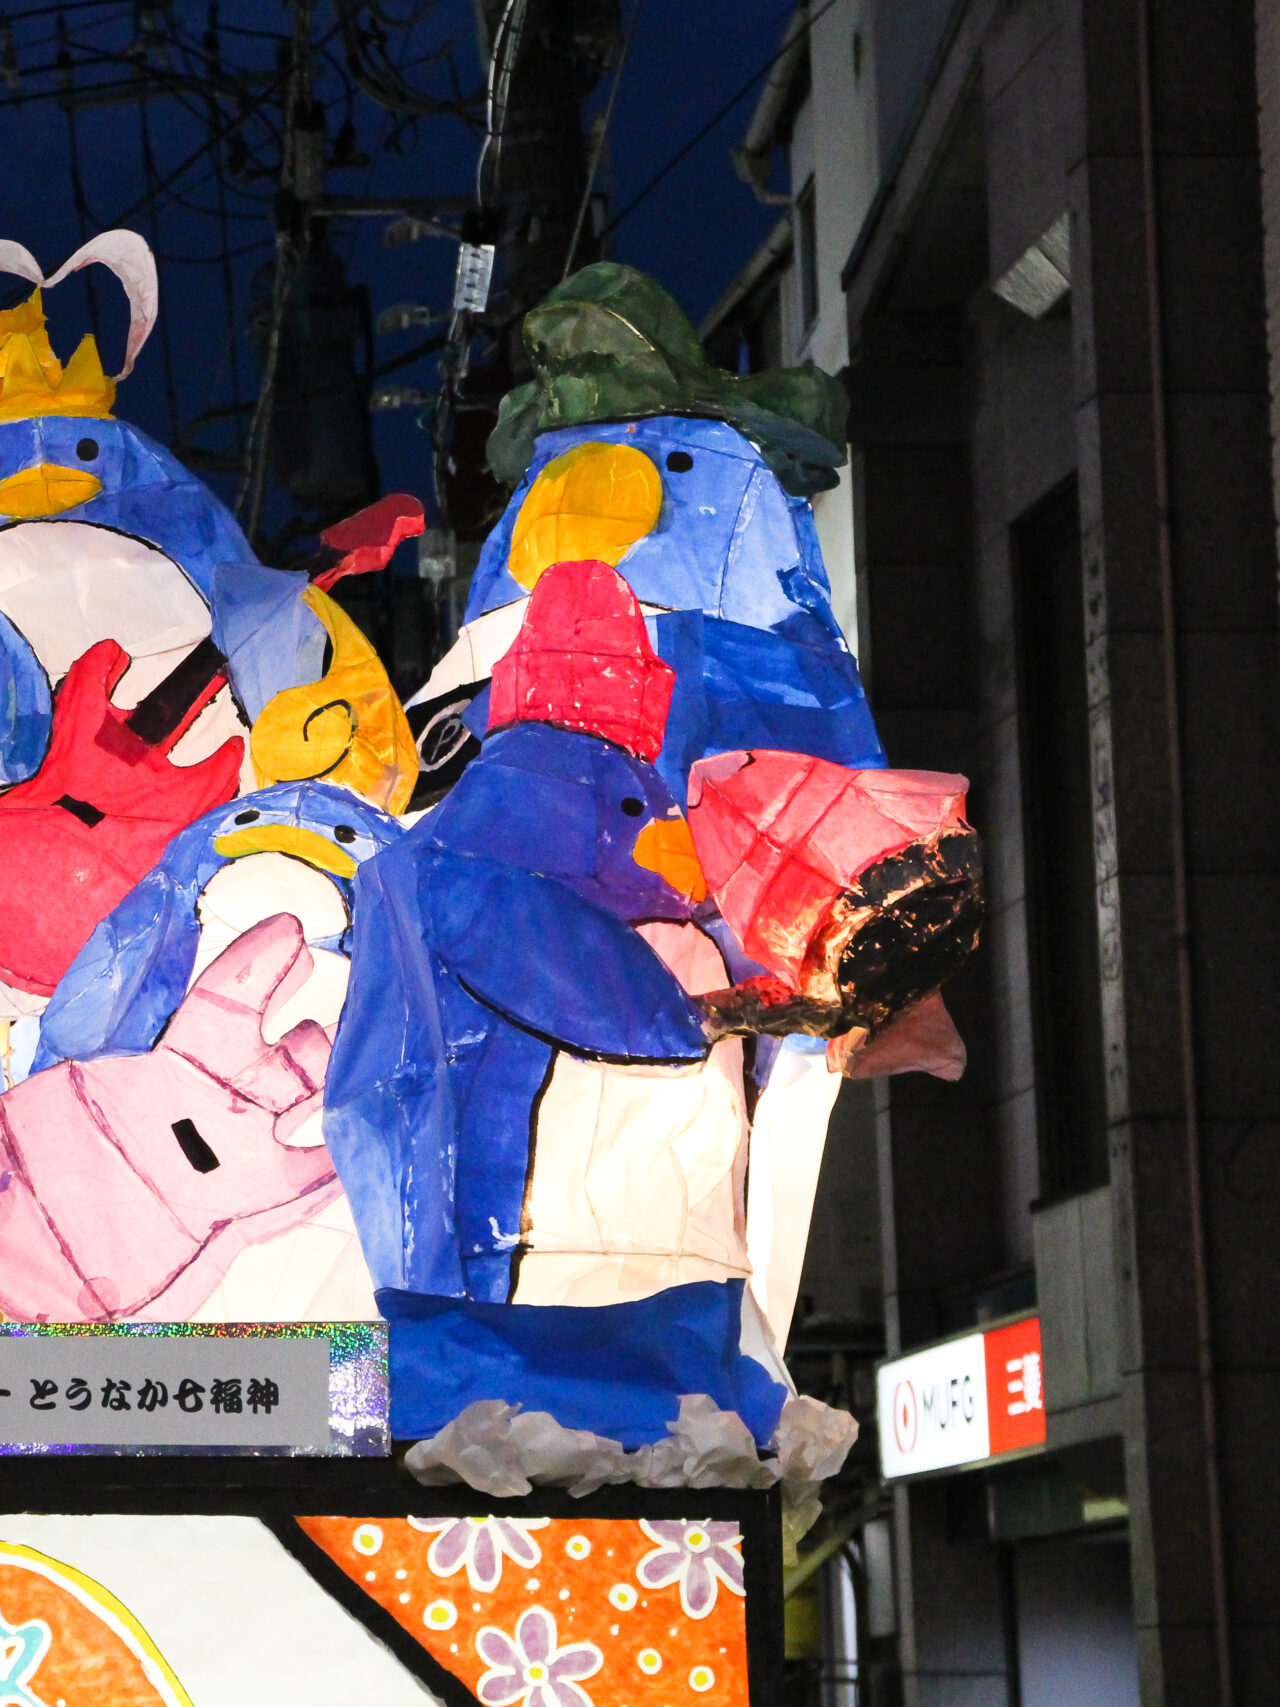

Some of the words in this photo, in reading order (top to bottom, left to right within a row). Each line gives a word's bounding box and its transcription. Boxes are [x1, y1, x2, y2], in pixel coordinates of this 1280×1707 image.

[30, 1377, 279, 1414] とうなか七福神
[922, 1375, 976, 1434] MUFG
